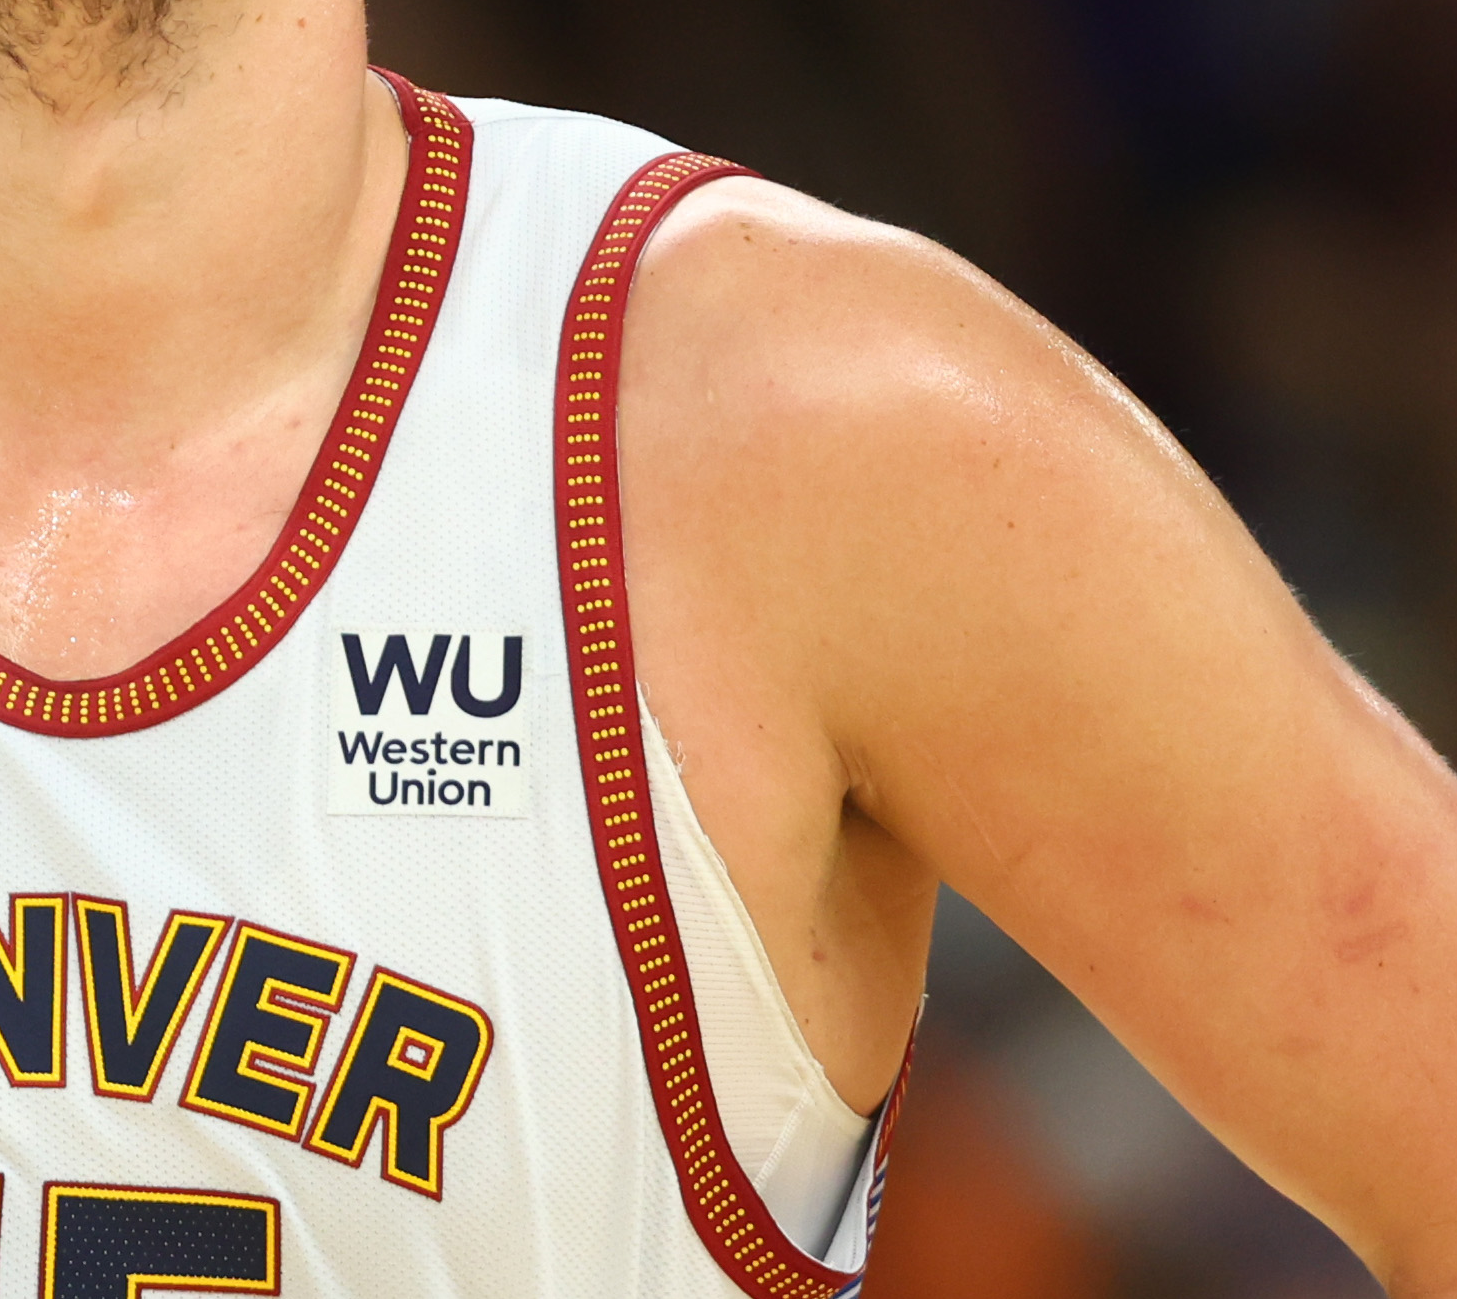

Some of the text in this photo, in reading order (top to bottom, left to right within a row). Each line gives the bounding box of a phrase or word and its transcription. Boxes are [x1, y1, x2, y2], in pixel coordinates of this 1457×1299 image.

[340, 632, 523, 719] WU
[337, 730, 521, 767] Western
[368, 767, 491, 807] Union
